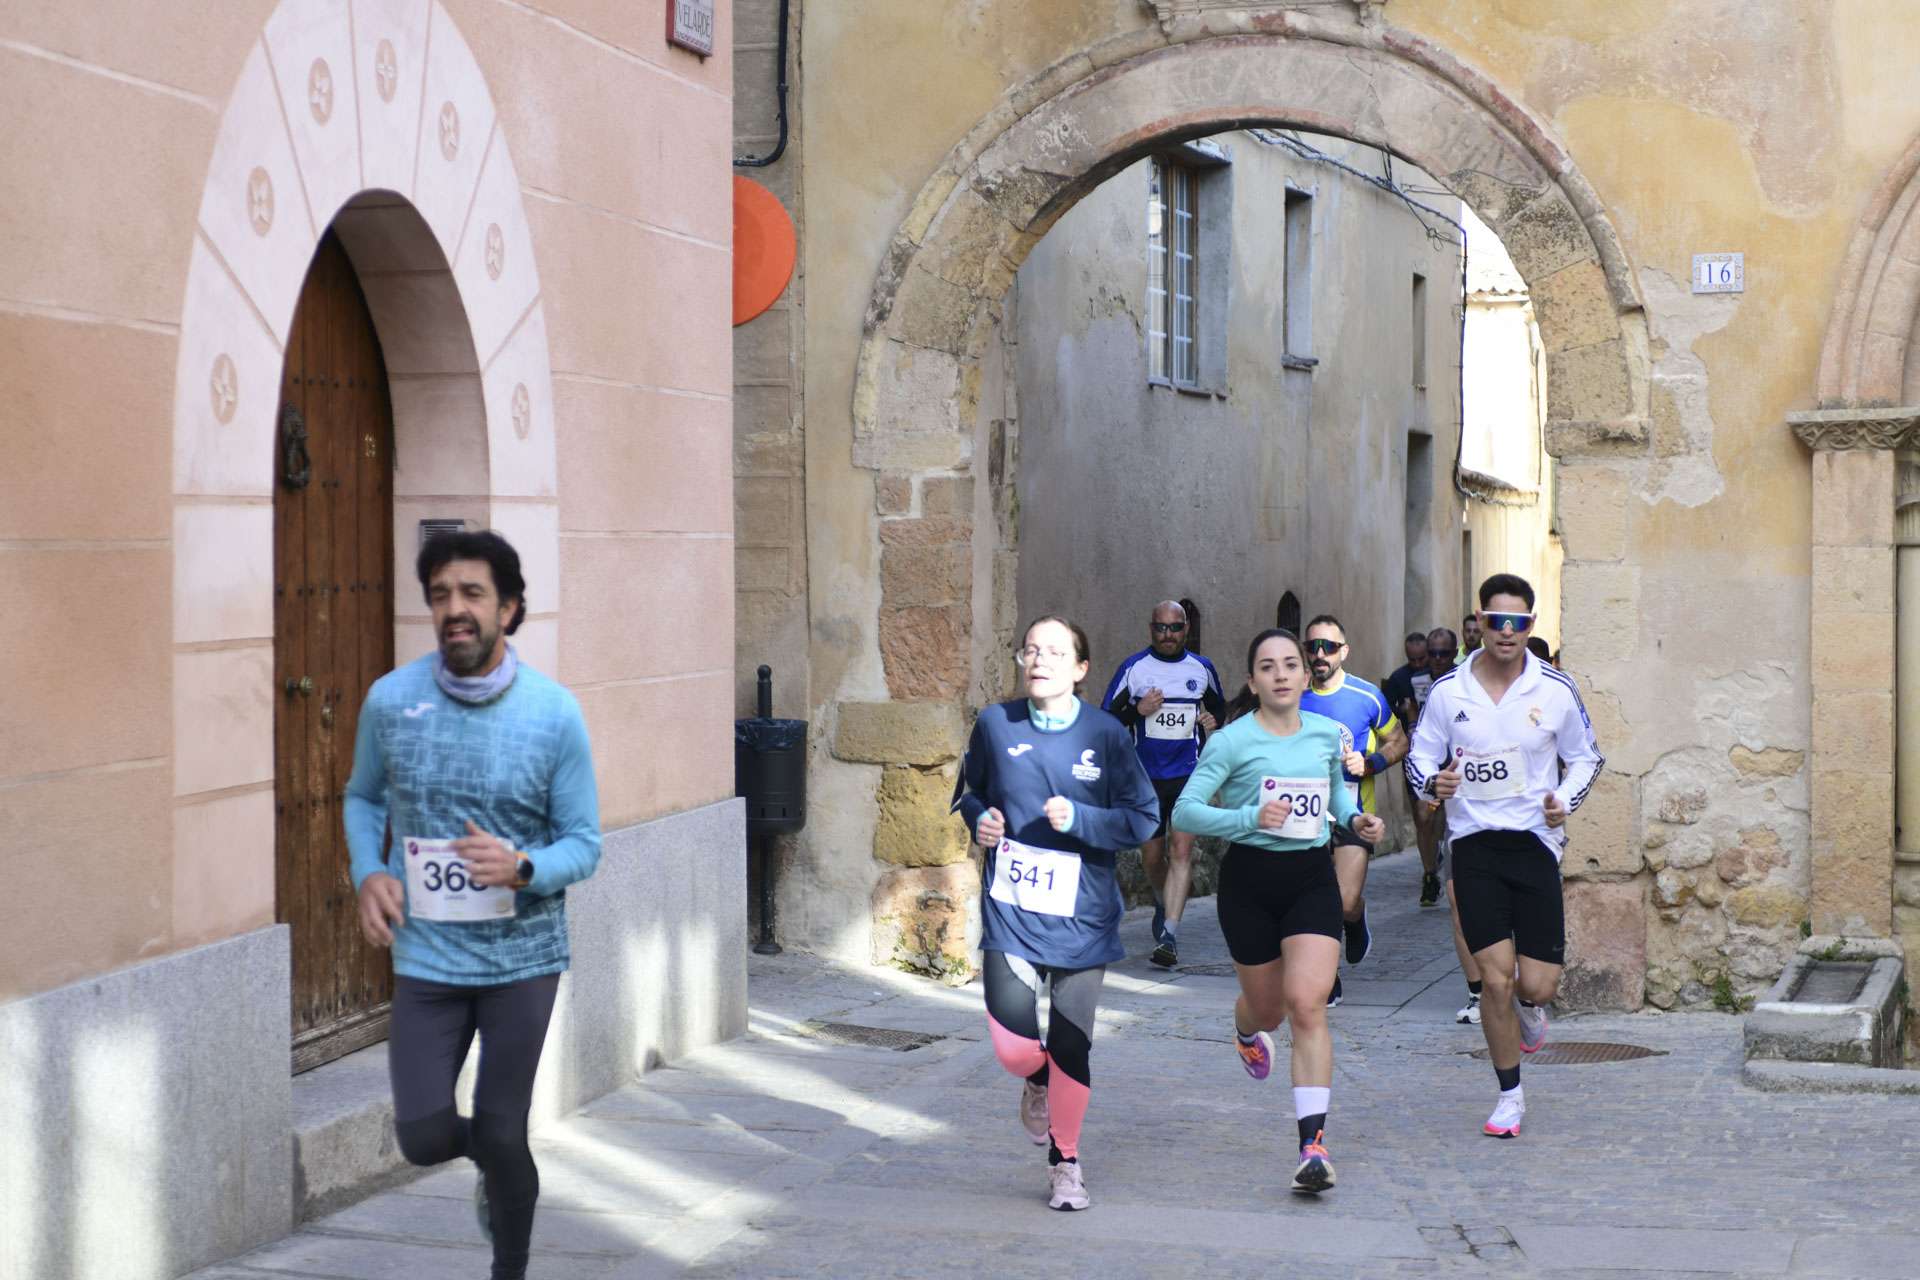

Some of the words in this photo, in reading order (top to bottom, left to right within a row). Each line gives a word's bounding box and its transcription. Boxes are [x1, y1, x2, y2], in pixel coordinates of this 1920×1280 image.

[1707, 262, 1730, 283] 16
[1155, 712, 1186, 727] 484
[1464, 760, 1508, 783] 658
[1009, 859, 1054, 891] 541
